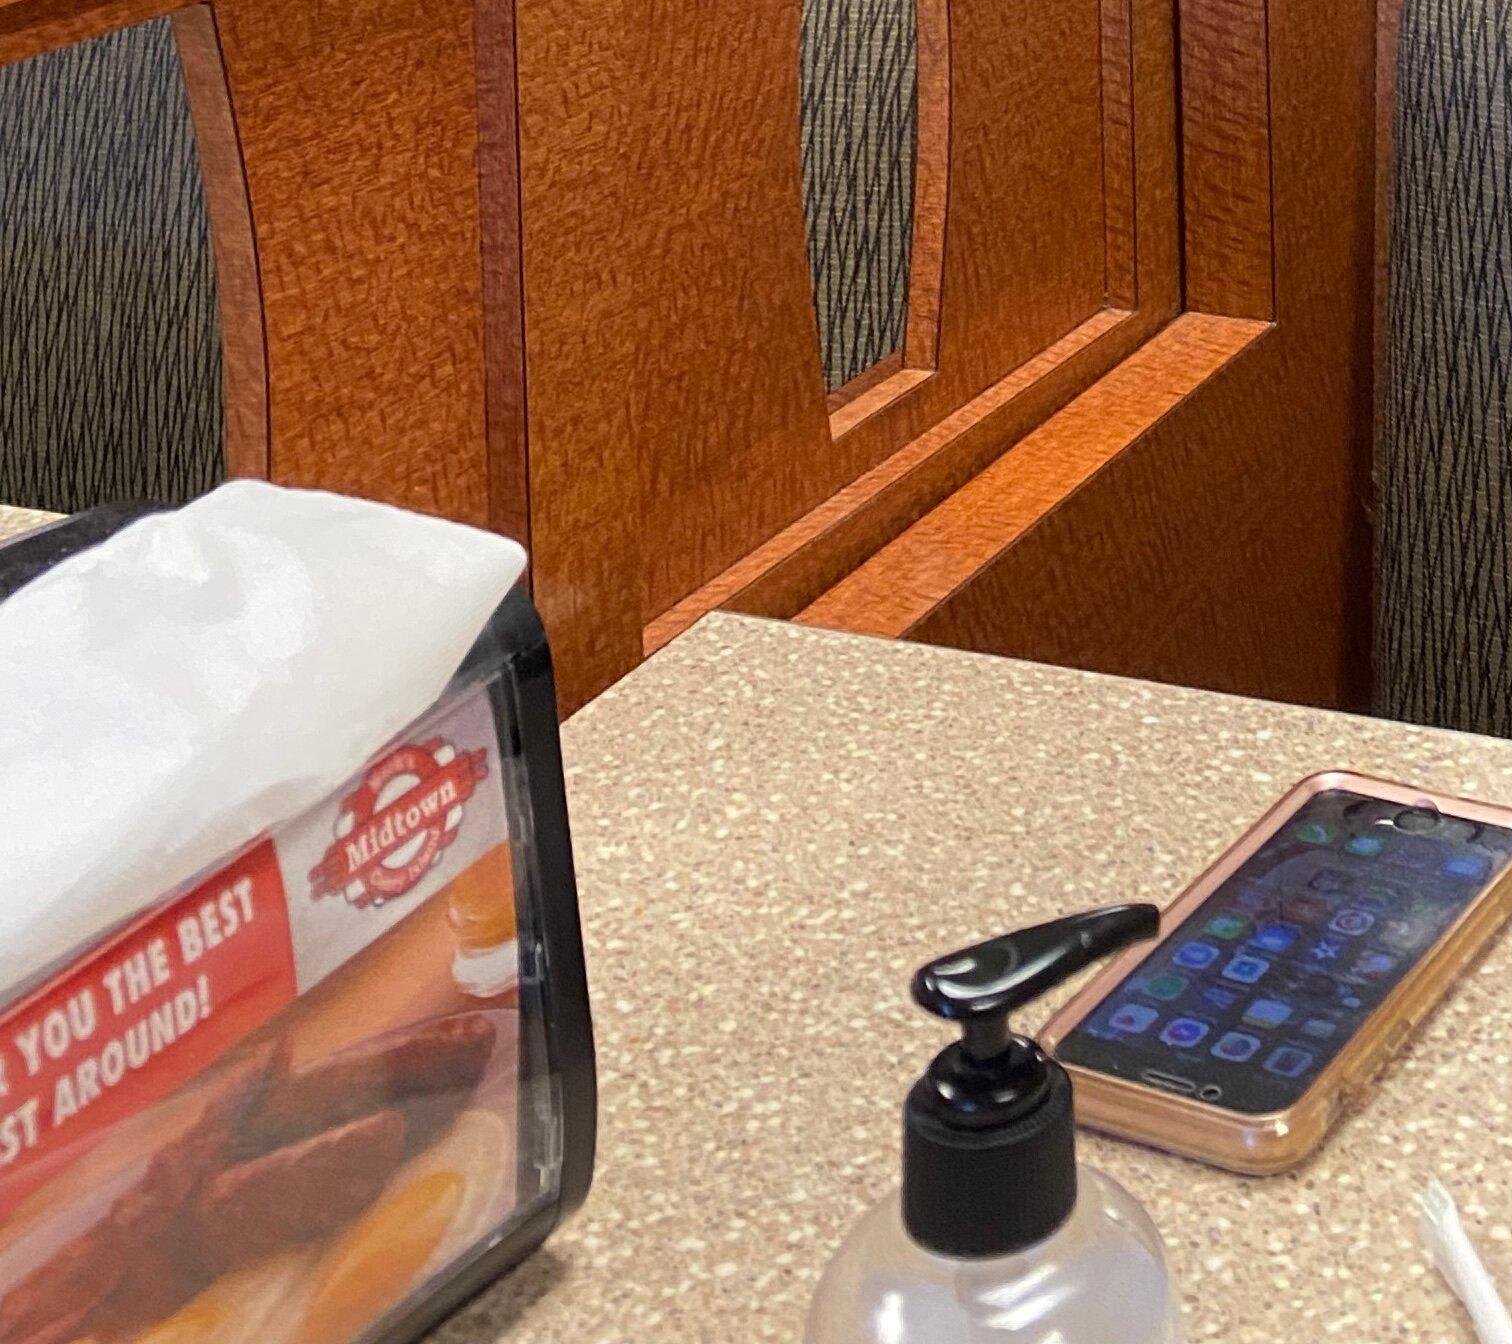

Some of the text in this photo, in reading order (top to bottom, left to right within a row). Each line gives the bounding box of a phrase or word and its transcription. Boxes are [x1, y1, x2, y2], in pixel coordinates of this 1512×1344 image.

[346, 780, 459, 874] Midtown
[14, 988, 97, 1077] YOU
[102, 938, 171, 1014] THE
[176, 877, 255, 965] BEST
[54, 974, 211, 1127] AROUND!
